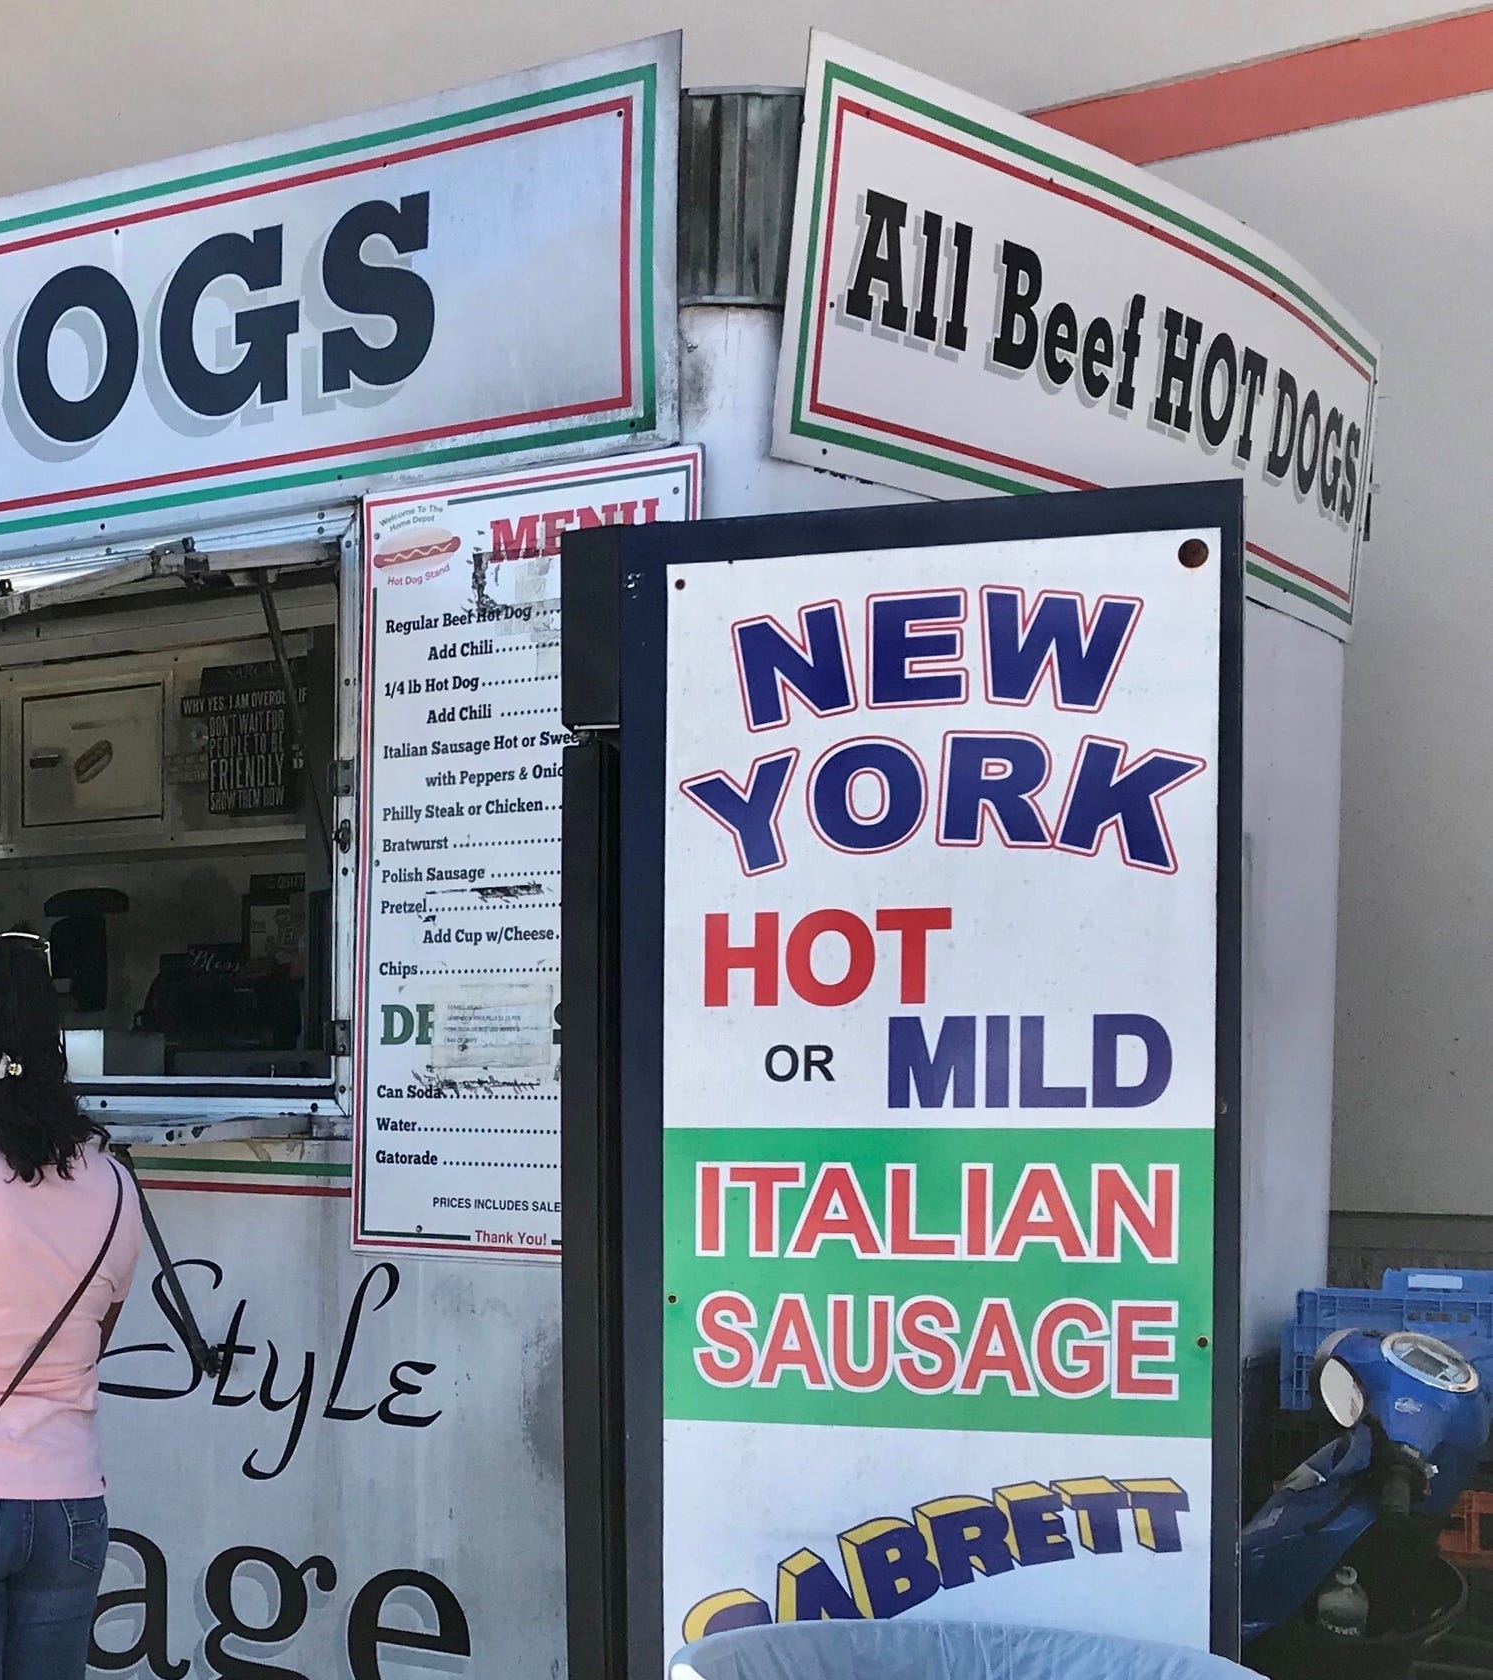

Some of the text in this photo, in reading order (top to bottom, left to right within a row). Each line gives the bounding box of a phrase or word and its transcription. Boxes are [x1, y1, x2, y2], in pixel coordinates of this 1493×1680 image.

[845, 189, 1362, 524] All Beef HOT DOGS
[387, 563, 451, 586] Hot Dog Stand
[385, 605, 533, 635] Regular Beef Hot Dog
[427, 639, 493, 661] Add Chili
[731, 584, 1145, 733] NEW
[384, 675, 480, 699] 1/4 lb Hot Dog
[426, 703, 493, 726] Add Chili
[383, 731, 580, 760] Italian Sausage Hot or Swee
[425, 770, 457, 787] with
[459, 768, 516, 787] Peppers
[518, 766, 528, 780] &
[382, 797, 544, 824] Philly Steak or Chicken
[680, 730, 1208, 878] YORK
[382, 835, 449, 853] Bratwurst
[381, 866, 486, 883] Polish Sausage
[380, 898, 428, 915] Pretzel
[422, 925, 554, 946] Add Cup w/Cheese
[703, 907, 953, 1008] HOT
[379, 961, 419, 979] Chips
[765, 1013, 1174, 1109] OR MILD
[376, 1084, 442, 1100] Can Soda
[376, 1117, 418, 1132] Water
[375, 1149, 439, 1166] Gatorade
[432, 1196, 562, 1213] PRICES INCLUDES SALE
[695, 1161, 1180, 1265] ITALIAN
[474, 1229, 547, 1246] Thank You!
[694, 1290, 1179, 1401] SAUSAGE
